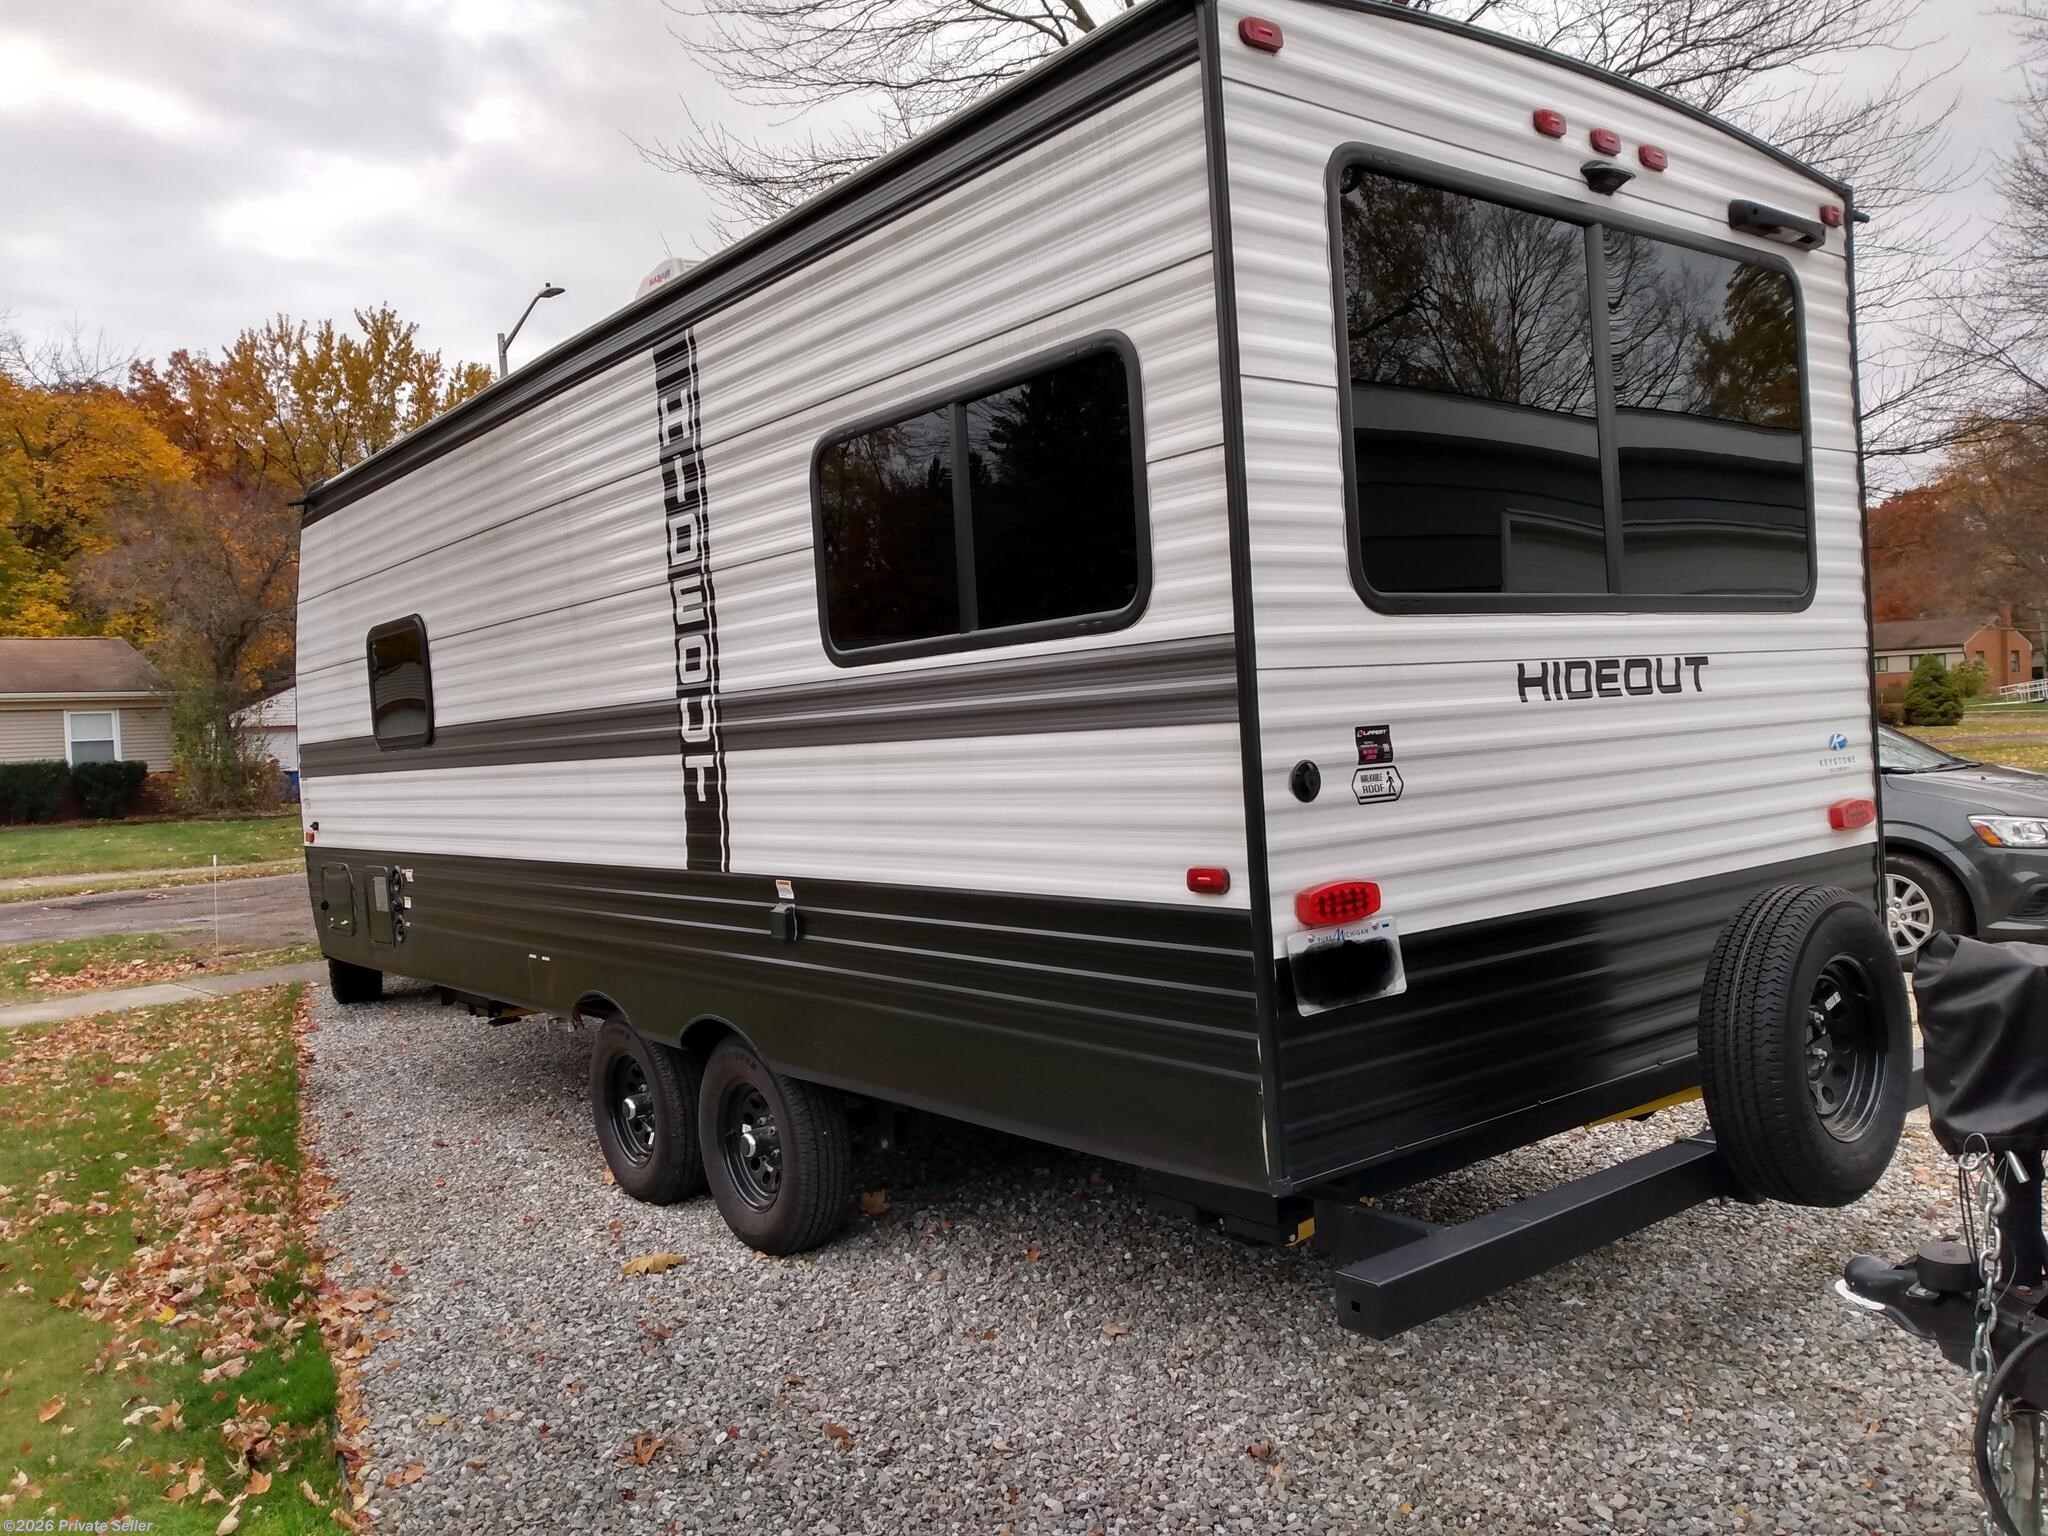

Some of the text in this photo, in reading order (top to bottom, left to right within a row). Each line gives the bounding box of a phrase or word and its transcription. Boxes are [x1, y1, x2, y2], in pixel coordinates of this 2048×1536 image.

[661, 389, 714, 802] HIDEOUT
[1517, 656, 1709, 702] HIDEOUT
[1819, 755, 1857, 767] KEYSTONE
[1360, 773, 1383, 783] WALKABLE
[1362, 783, 1385, 794] ROOF
[1332, 928, 1369, 943] MICHIGAN
